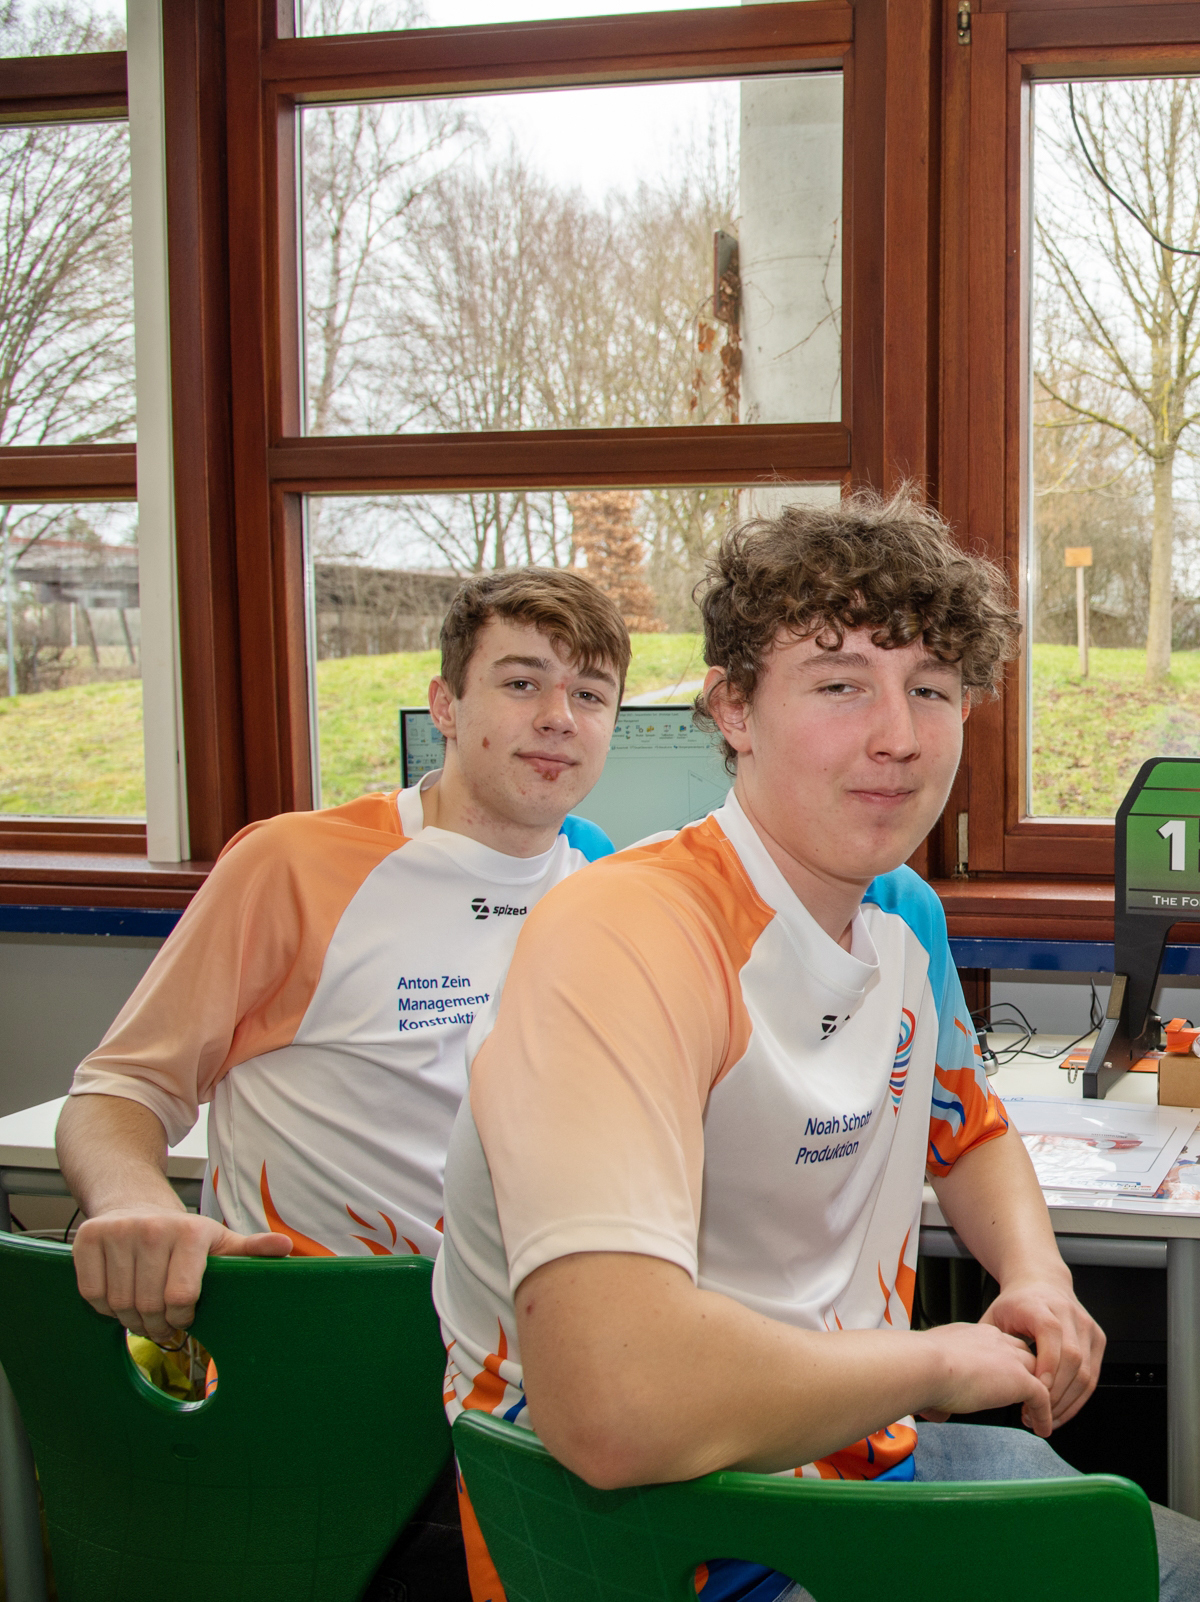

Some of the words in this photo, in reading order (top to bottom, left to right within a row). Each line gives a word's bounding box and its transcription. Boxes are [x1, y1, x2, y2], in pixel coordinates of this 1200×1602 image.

[1157, 820, 1186, 871] 1
[493, 904, 527, 916] spized
[1152, 895, 1178, 906] THE
[397, 977, 438, 990] Anton
[441, 976, 471, 988] Zein
[398, 993, 490, 1012] Management
[804, 1116, 840, 1136] Noah
[795, 1140, 859, 1165] Produktion
